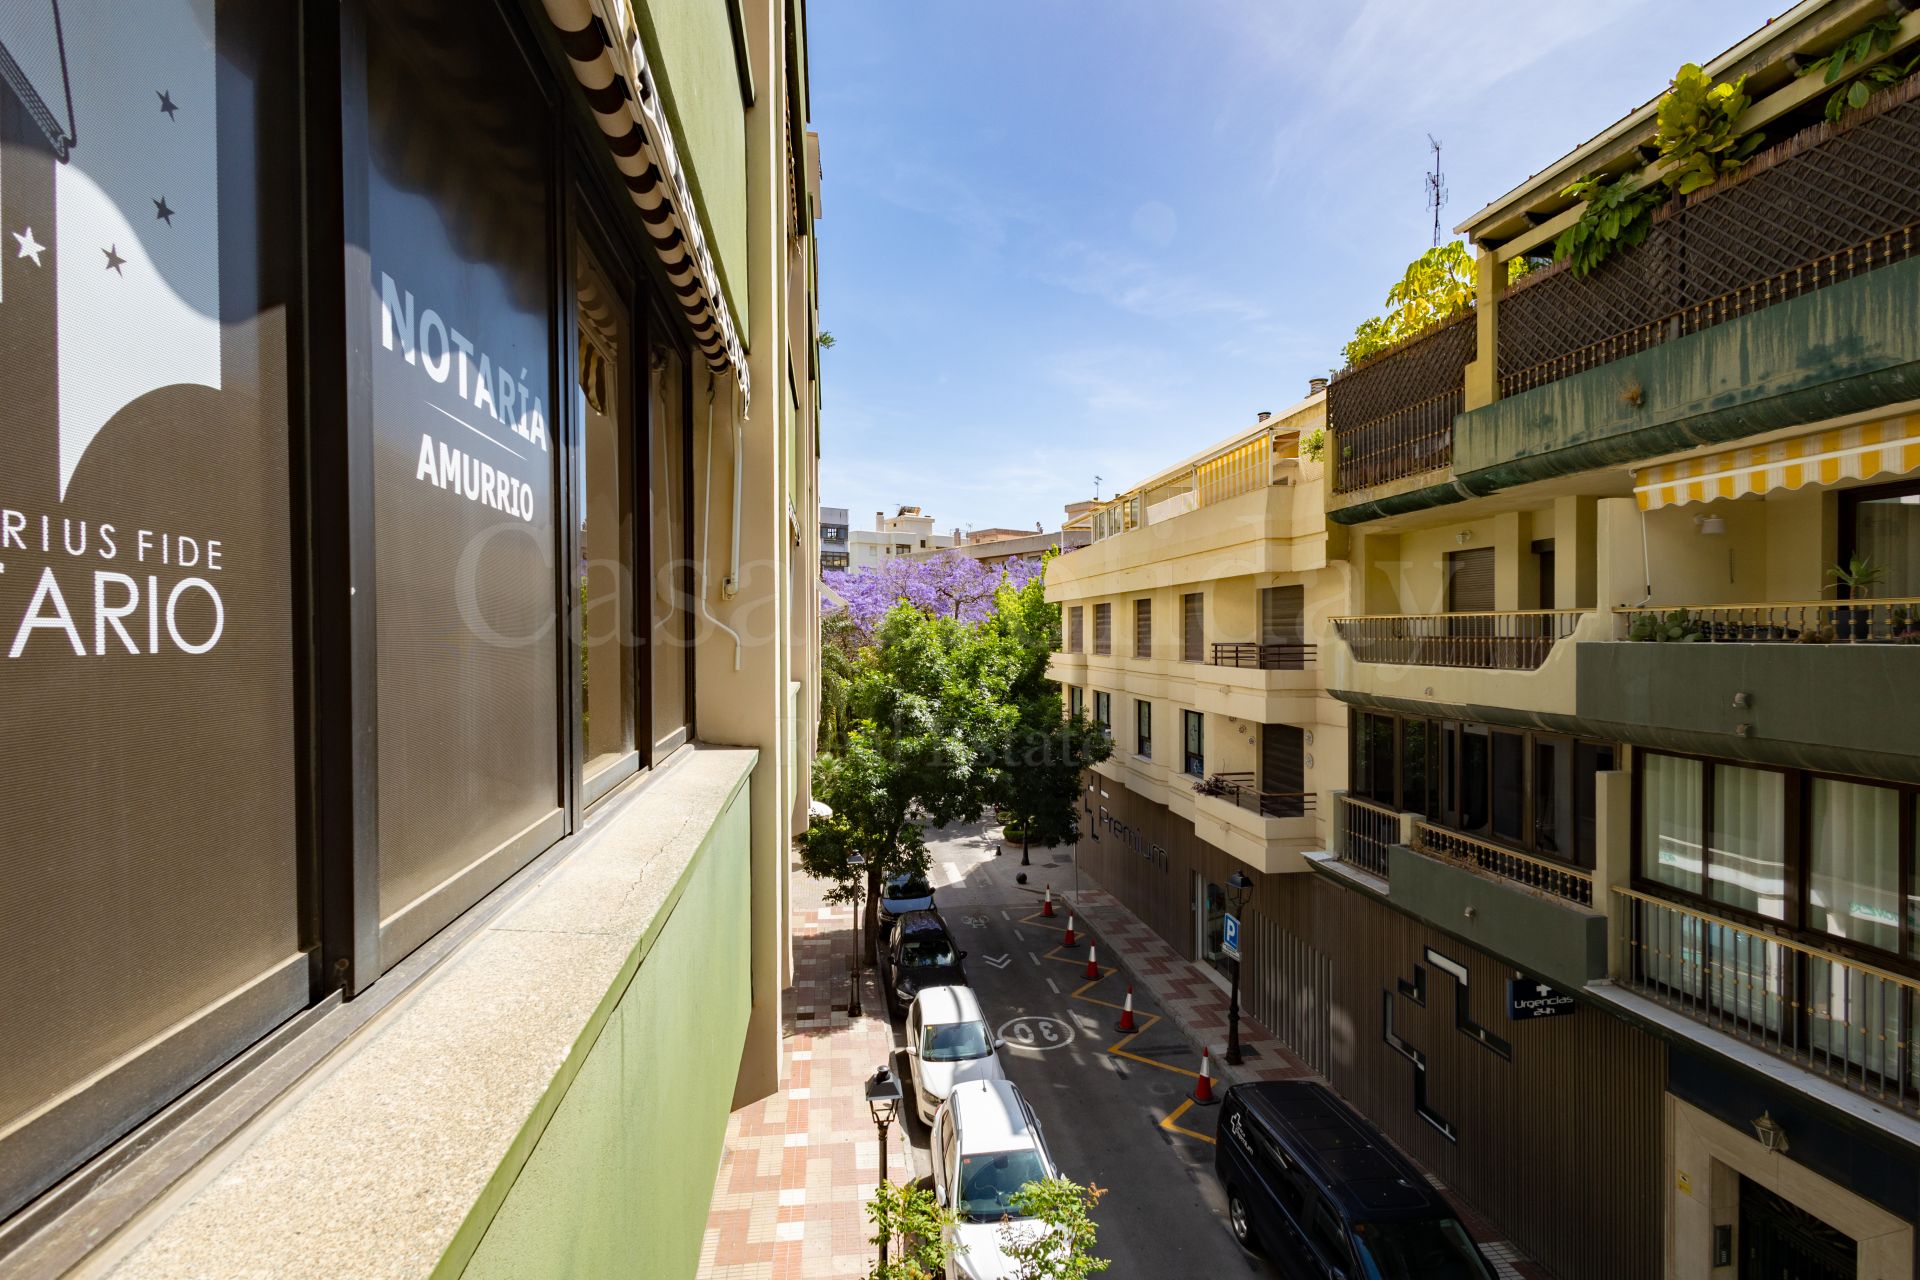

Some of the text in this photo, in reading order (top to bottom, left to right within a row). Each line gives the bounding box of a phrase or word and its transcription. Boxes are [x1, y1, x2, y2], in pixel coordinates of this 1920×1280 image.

[382, 271, 547, 452] NOTARÍA
[416, 433, 534, 522] AMURRIO
[138, 530, 222, 570] FIDE
[0, 562, 224, 658] ARIO
[1099, 804, 1168, 873] Premium
[1226, 918, 1236, 941] P
[1514, 996, 1574, 1008] Urgencias
[1013, 1021, 1059, 1044] 30
